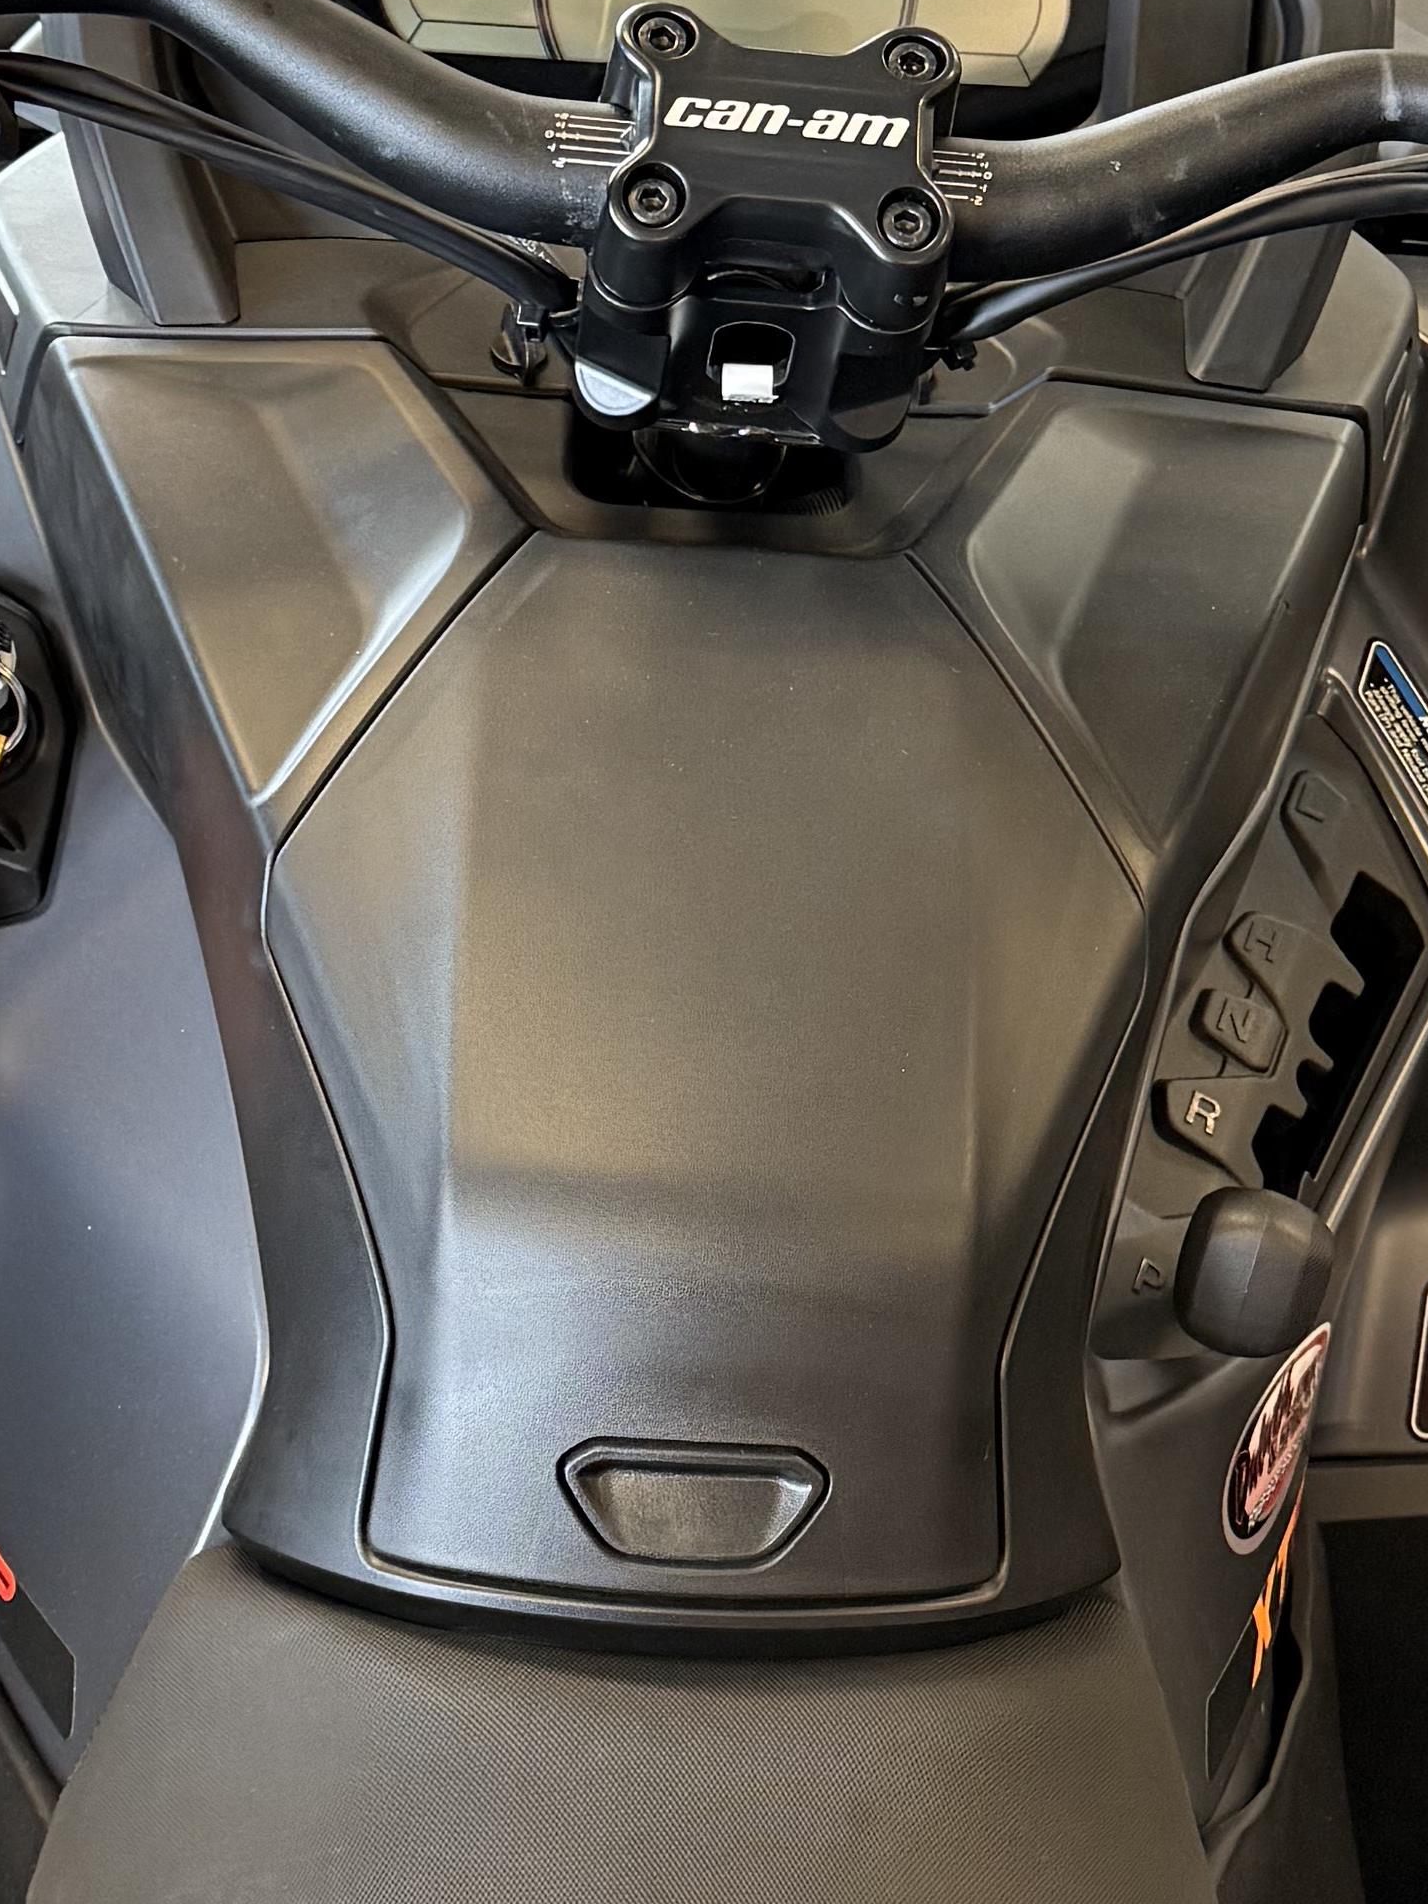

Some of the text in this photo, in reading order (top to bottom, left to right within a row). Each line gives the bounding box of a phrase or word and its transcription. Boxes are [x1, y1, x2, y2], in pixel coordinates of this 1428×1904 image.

[664, 95, 911, 149] can-am
[1243, 919, 1278, 964] H
[1216, 998, 1252, 1045] N
[1185, 1089, 1221, 1136] R
[1131, 1256, 1165, 1294] P
